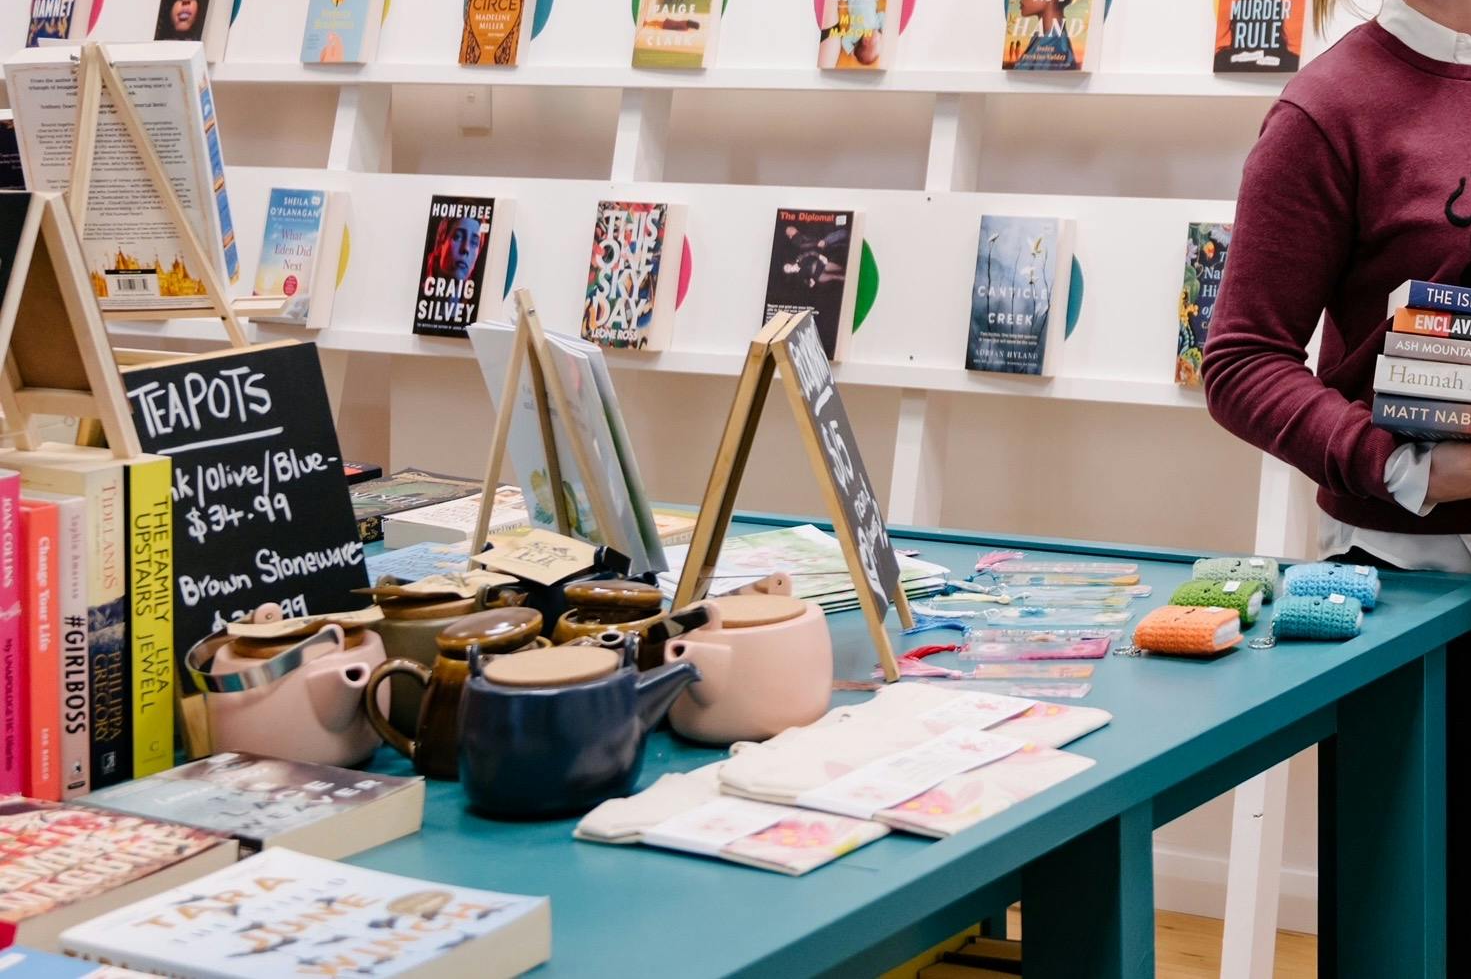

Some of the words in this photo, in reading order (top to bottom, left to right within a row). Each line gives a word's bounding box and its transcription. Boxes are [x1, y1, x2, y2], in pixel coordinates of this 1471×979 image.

[1011, 18, 1085, 38] HAND
[1234, 22, 1282, 49] RULE
[283, 196, 309, 207] SHEILA
[431, 202, 492, 220] HONEYBEE
[780, 211, 796, 221] The
[798, 212, 835, 223] Diplomat
[296, 244, 313, 258] Did
[424, 276, 475, 300] CRAIG
[977, 285, 1049, 303] CANTICLE
[1426, 287, 1453, 305] THE
[417, 299, 476, 324] SILVEY
[988, 312, 1034, 327] CREEK
[1394, 340, 1420, 353] ASH
[1389, 364, 1464, 390] Hannah
[127, 366, 272, 439] TEAPOTS
[1383, 403, 1430, 422] MATT
[152, 495, 169, 545] THE
[187, 493, 292, 544] $34.99
[101, 480, 118, 591] TIDELANDS
[36, 535, 52, 588] Change
[134, 513, 153, 618] UPSTAIRS
[178, 574, 252, 607] Brown
[255, 541, 364, 584] Stoneware
[154, 548, 170, 623] FAMILY
[37, 589, 52, 623] Your
[38, 623, 51, 652] Life
[65, 615, 87, 735] #GIRLBOSS
[136, 634, 155, 715] JEWELL
[155, 646, 169, 693] LISA
[94, 653, 109, 743] GREGORY
[106, 651, 123, 740] PHILIPPA
